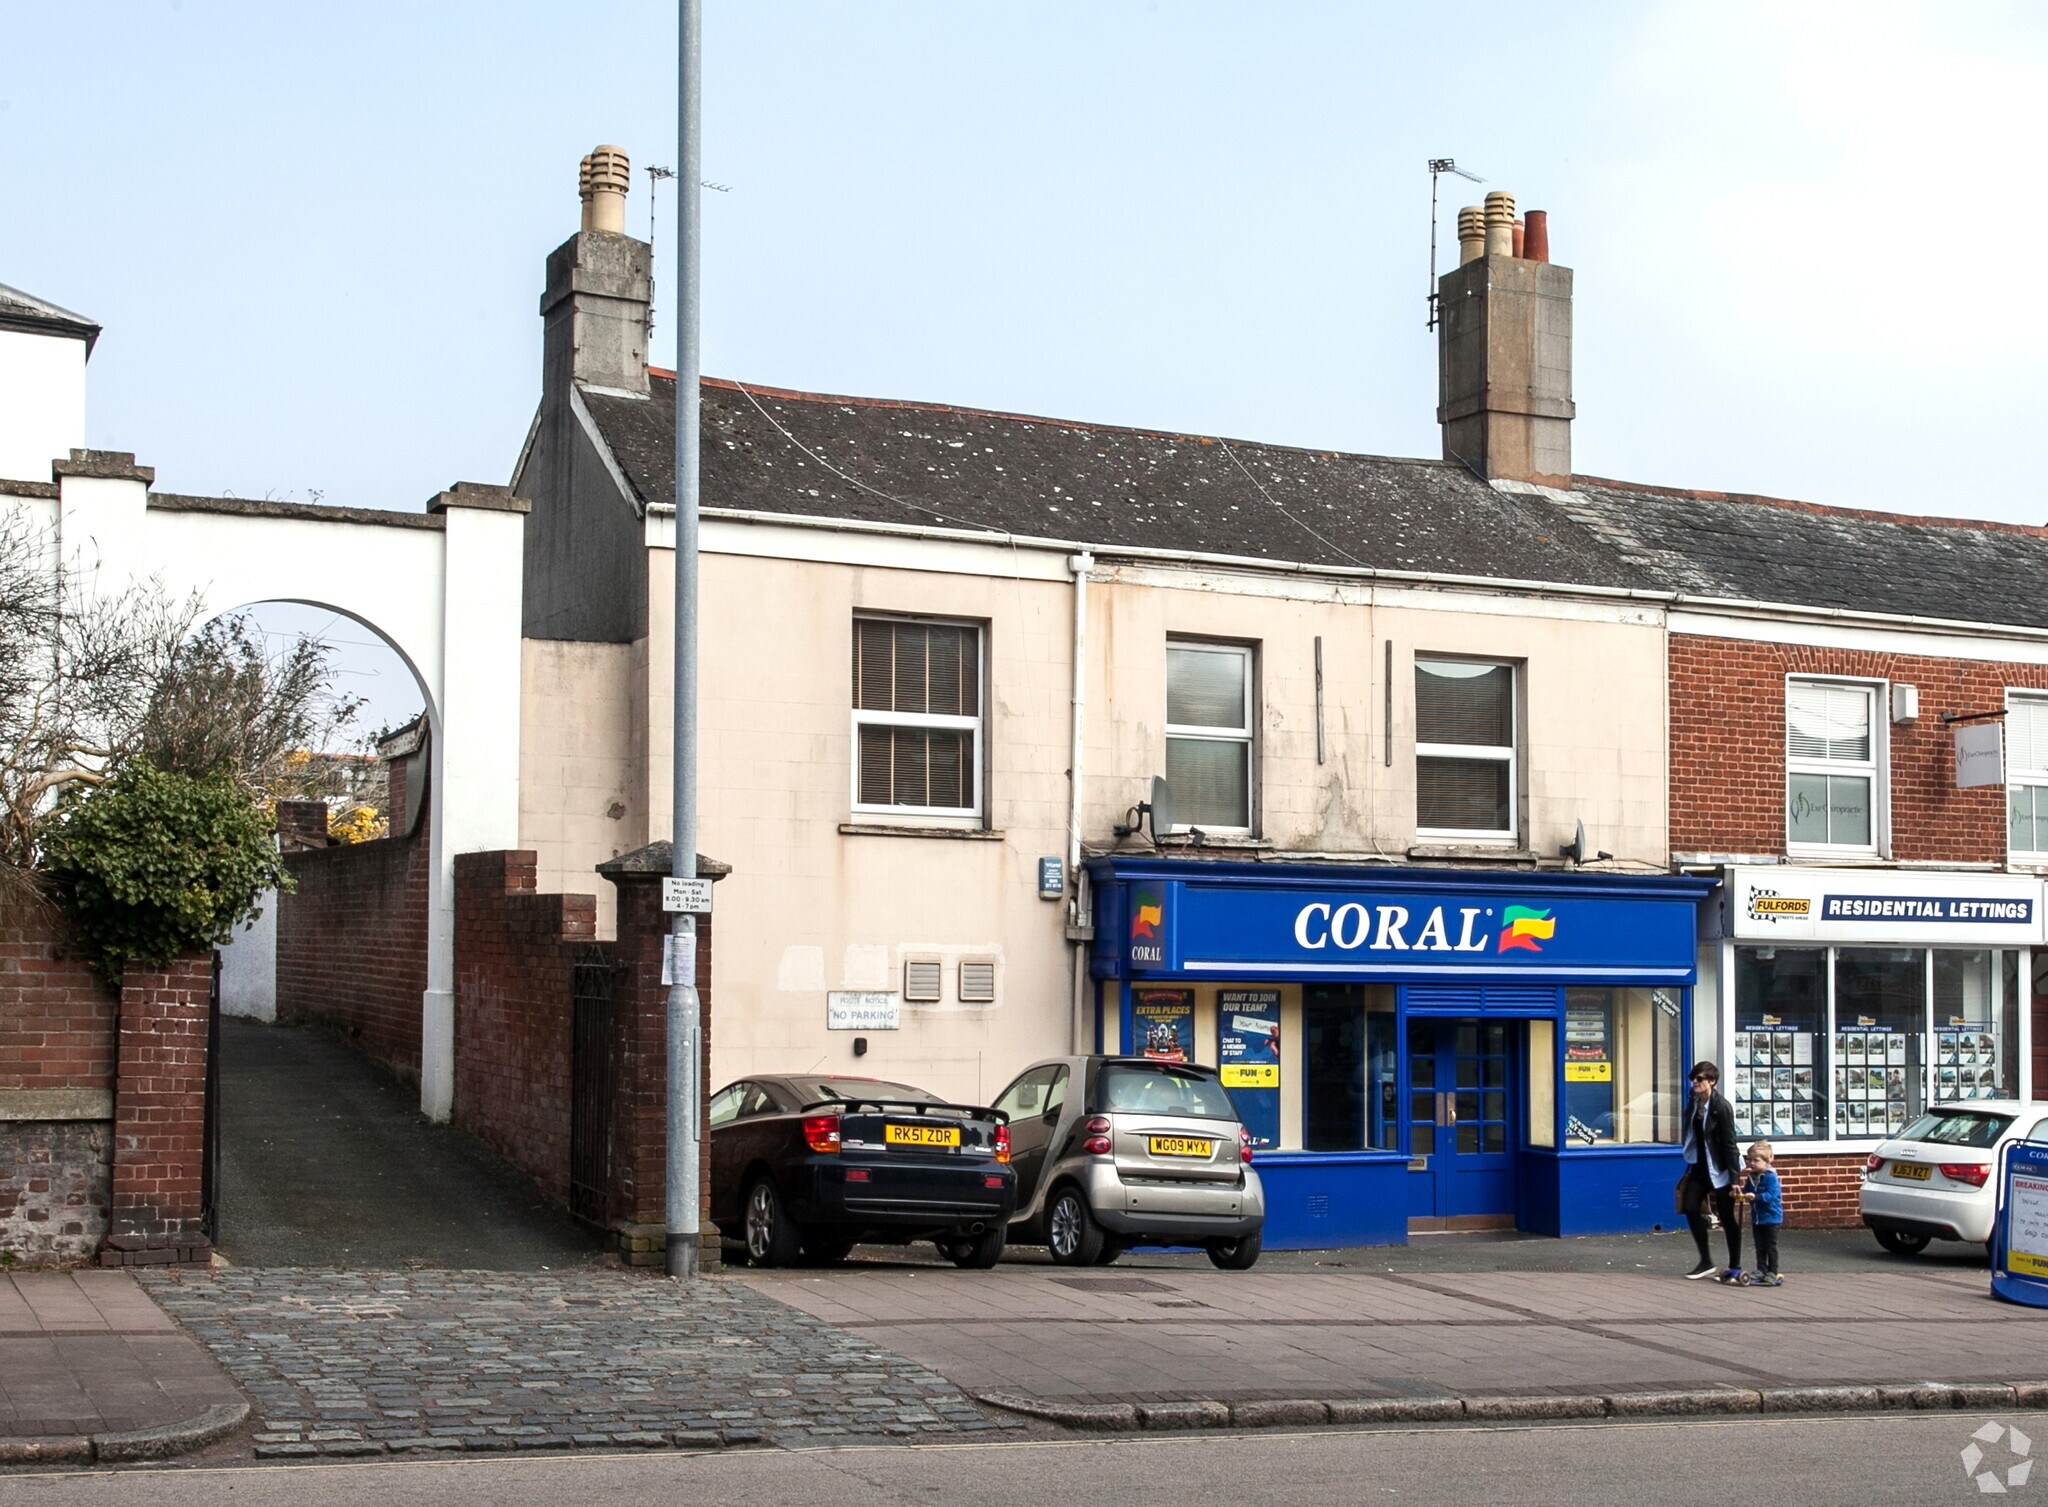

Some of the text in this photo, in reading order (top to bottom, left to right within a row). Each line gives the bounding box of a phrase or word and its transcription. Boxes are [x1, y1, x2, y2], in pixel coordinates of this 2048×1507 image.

[682, 880, 705, 888] loading
[1757, 901, 1808, 911] FULFORDS
[1829, 900, 2028, 919] RESIDENTIAL LETTINGS
[1294, 902, 1488, 952] CORAL
[1131, 945, 1161, 962] CORAL
[1223, 993, 1277, 1002] WANT TO JOIN
[1136, 1006, 1190, 1014] EXTRA PLACES
[1222, 1003, 1268, 1012] OUR TEAM?
[833, 1010, 894, 1020] NO PARKING
[1240, 1069, 1258, 1077] FUN
[894, 1127, 952, 1143] RK51 ZDR
[1155, 1138, 1206, 1153] WG09 MYX
